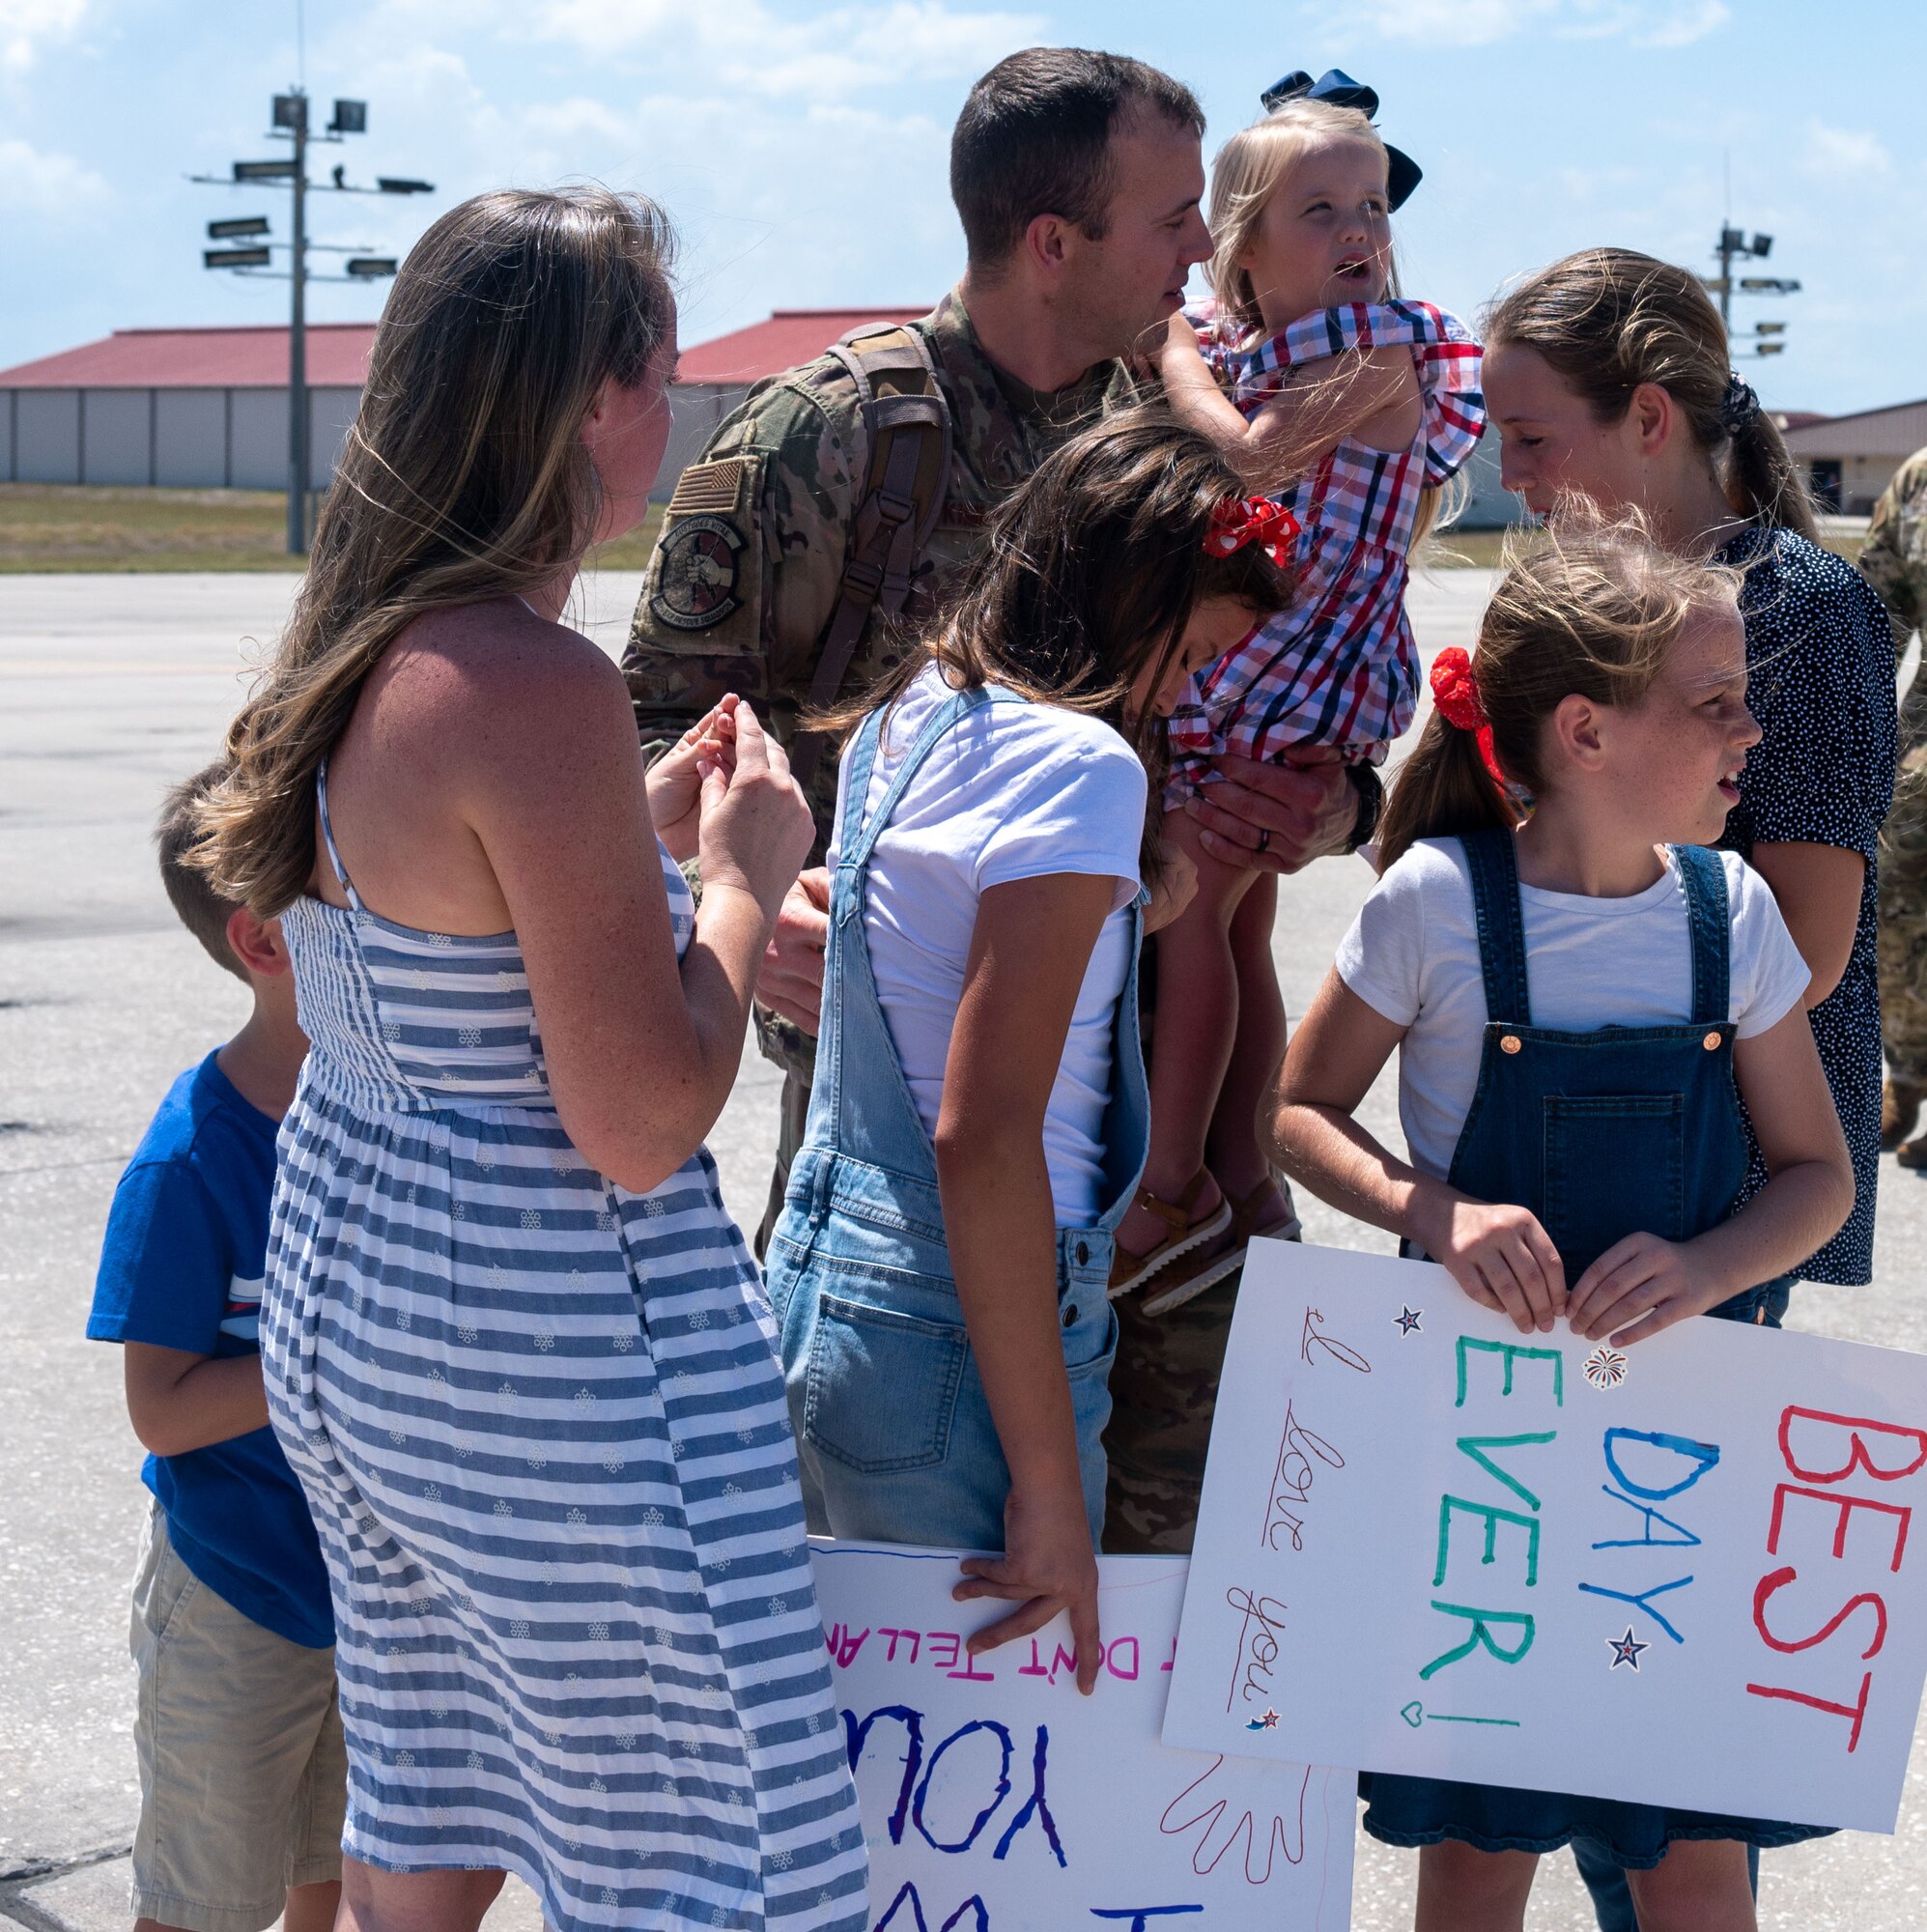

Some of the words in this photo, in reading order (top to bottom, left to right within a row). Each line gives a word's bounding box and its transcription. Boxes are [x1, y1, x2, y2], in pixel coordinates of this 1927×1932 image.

[1269, 1411, 1346, 1551] love
[1402, 1335, 1564, 1727] EVER!
[1578, 1427, 1719, 1645] DAY
[877, 1627, 995, 1682] TELL
[1226, 1586, 1288, 1702] you
[1746, 1406, 1927, 1753] BEST
[839, 1703, 1068, 1868] YOU
